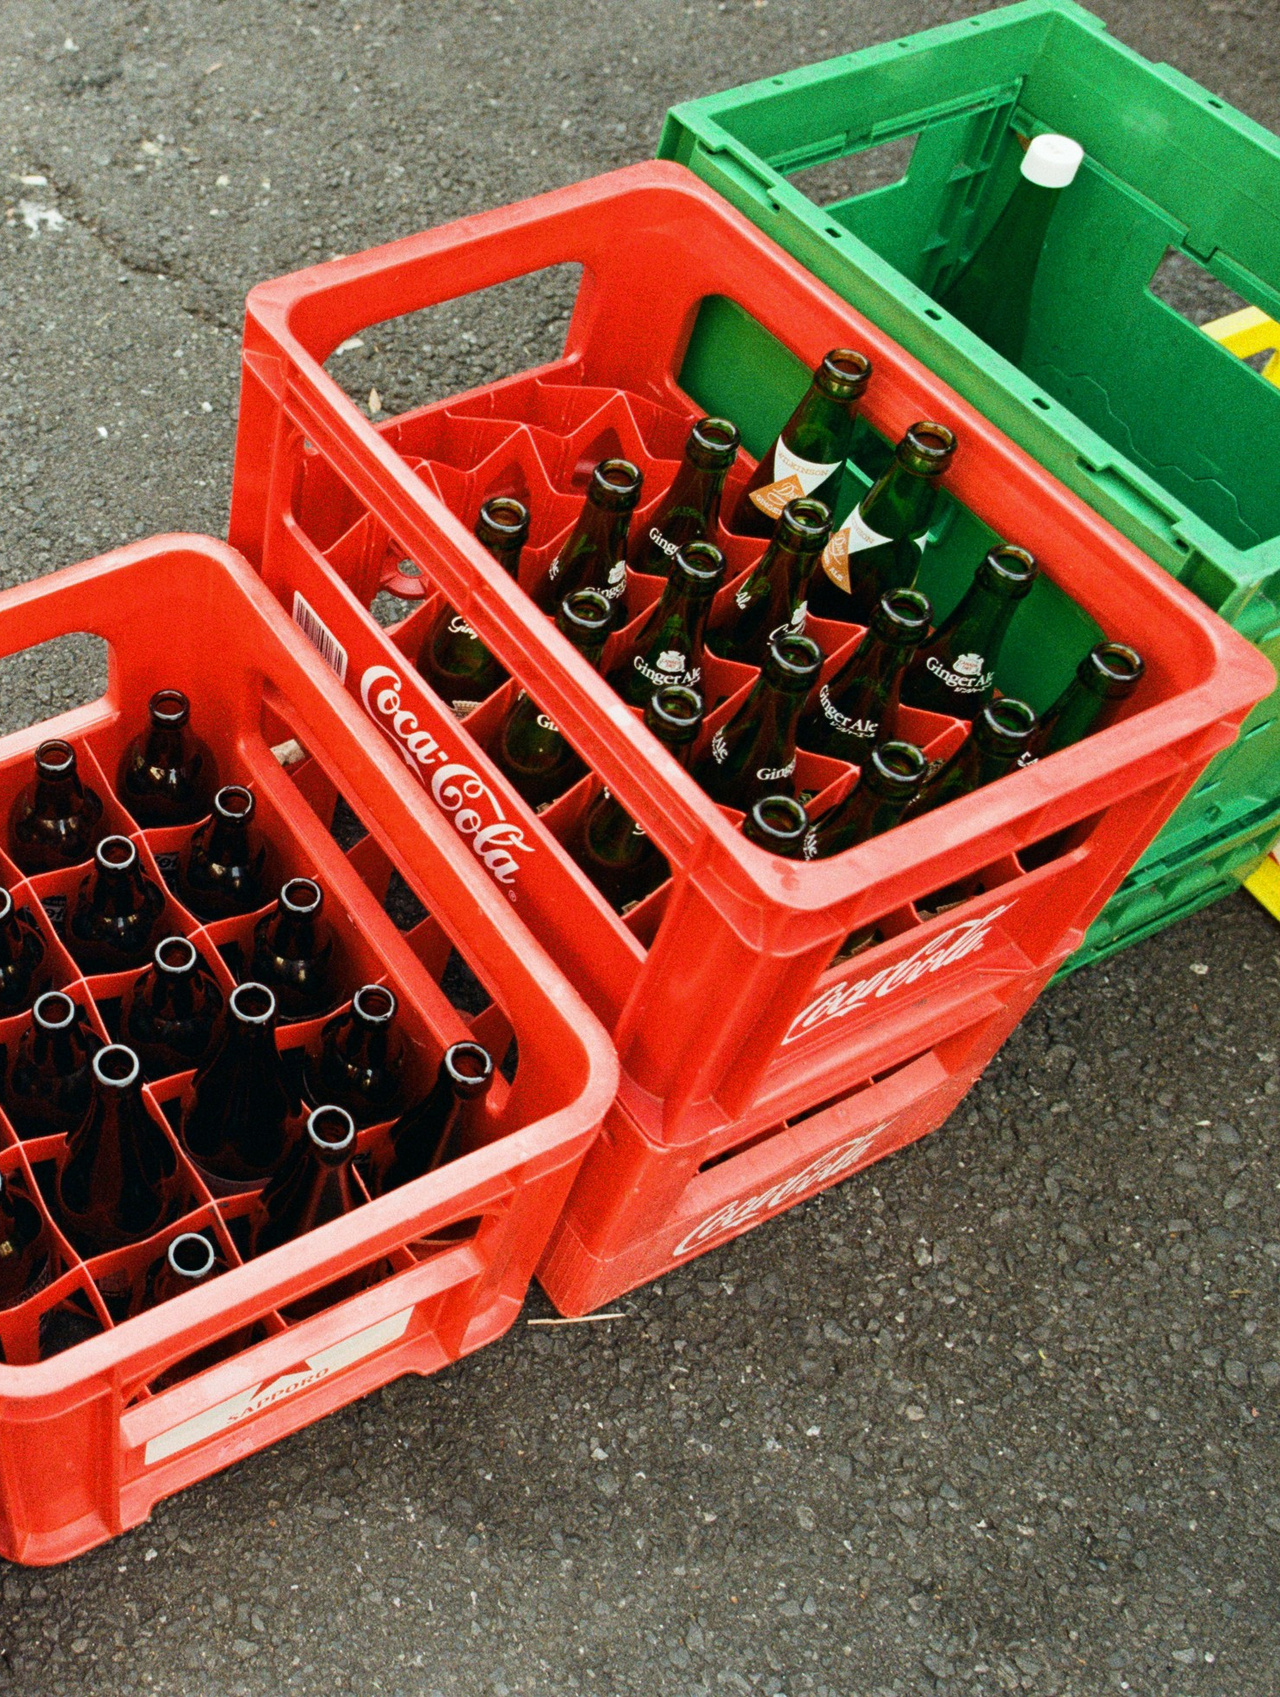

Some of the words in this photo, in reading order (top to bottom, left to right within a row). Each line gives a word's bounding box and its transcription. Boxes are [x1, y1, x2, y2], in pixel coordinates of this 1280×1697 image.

[633, 655, 682, 686] Ginger
[926, 656, 977, 687] Ginger
[820, 684, 852, 727] Ginger
[849, 718, 879, 733] Ale
[360, 665, 535, 886] Coca-Cola
[781, 898, 1020, 1046] Coca-Cola
[228, 1367, 329, 1425] SAPPORO
